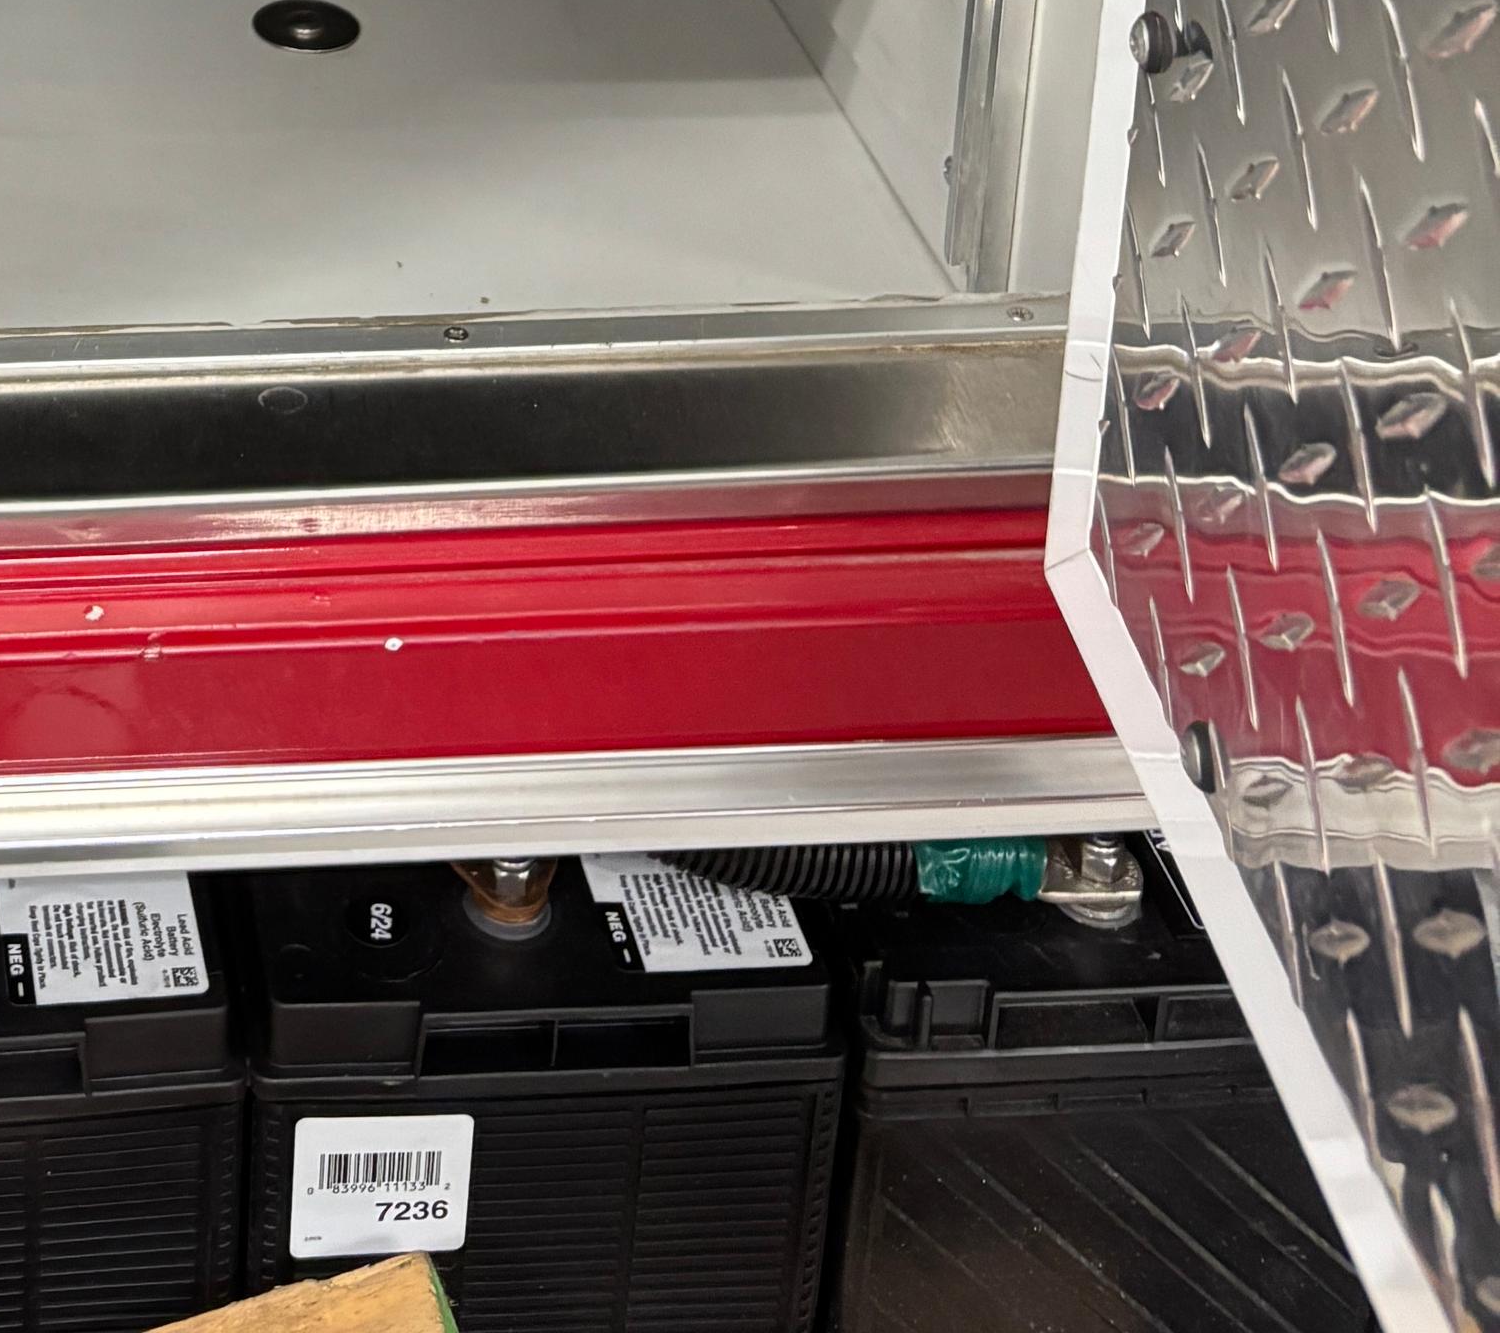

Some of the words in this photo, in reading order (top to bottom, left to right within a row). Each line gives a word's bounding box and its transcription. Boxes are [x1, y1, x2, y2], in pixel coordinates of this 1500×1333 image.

[148, 913, 167, 957] Electrolyte
[370, 903, 393, 940] 6/24
[605, 911, 627, 943] NEG
[139, 938, 154, 960] Acid)
[164, 926, 181, 956] Battery
[181, 936, 194, 954] Acid
[7, 943, 25, 976] NEG
[307, 1187, 314, 1195] 0
[332, 1182, 376, 1194] 83996
[384, 1181, 426, 1193] 11133
[444, 1182, 451, 1190] 2
[375, 1199, 449, 1222] 7236
